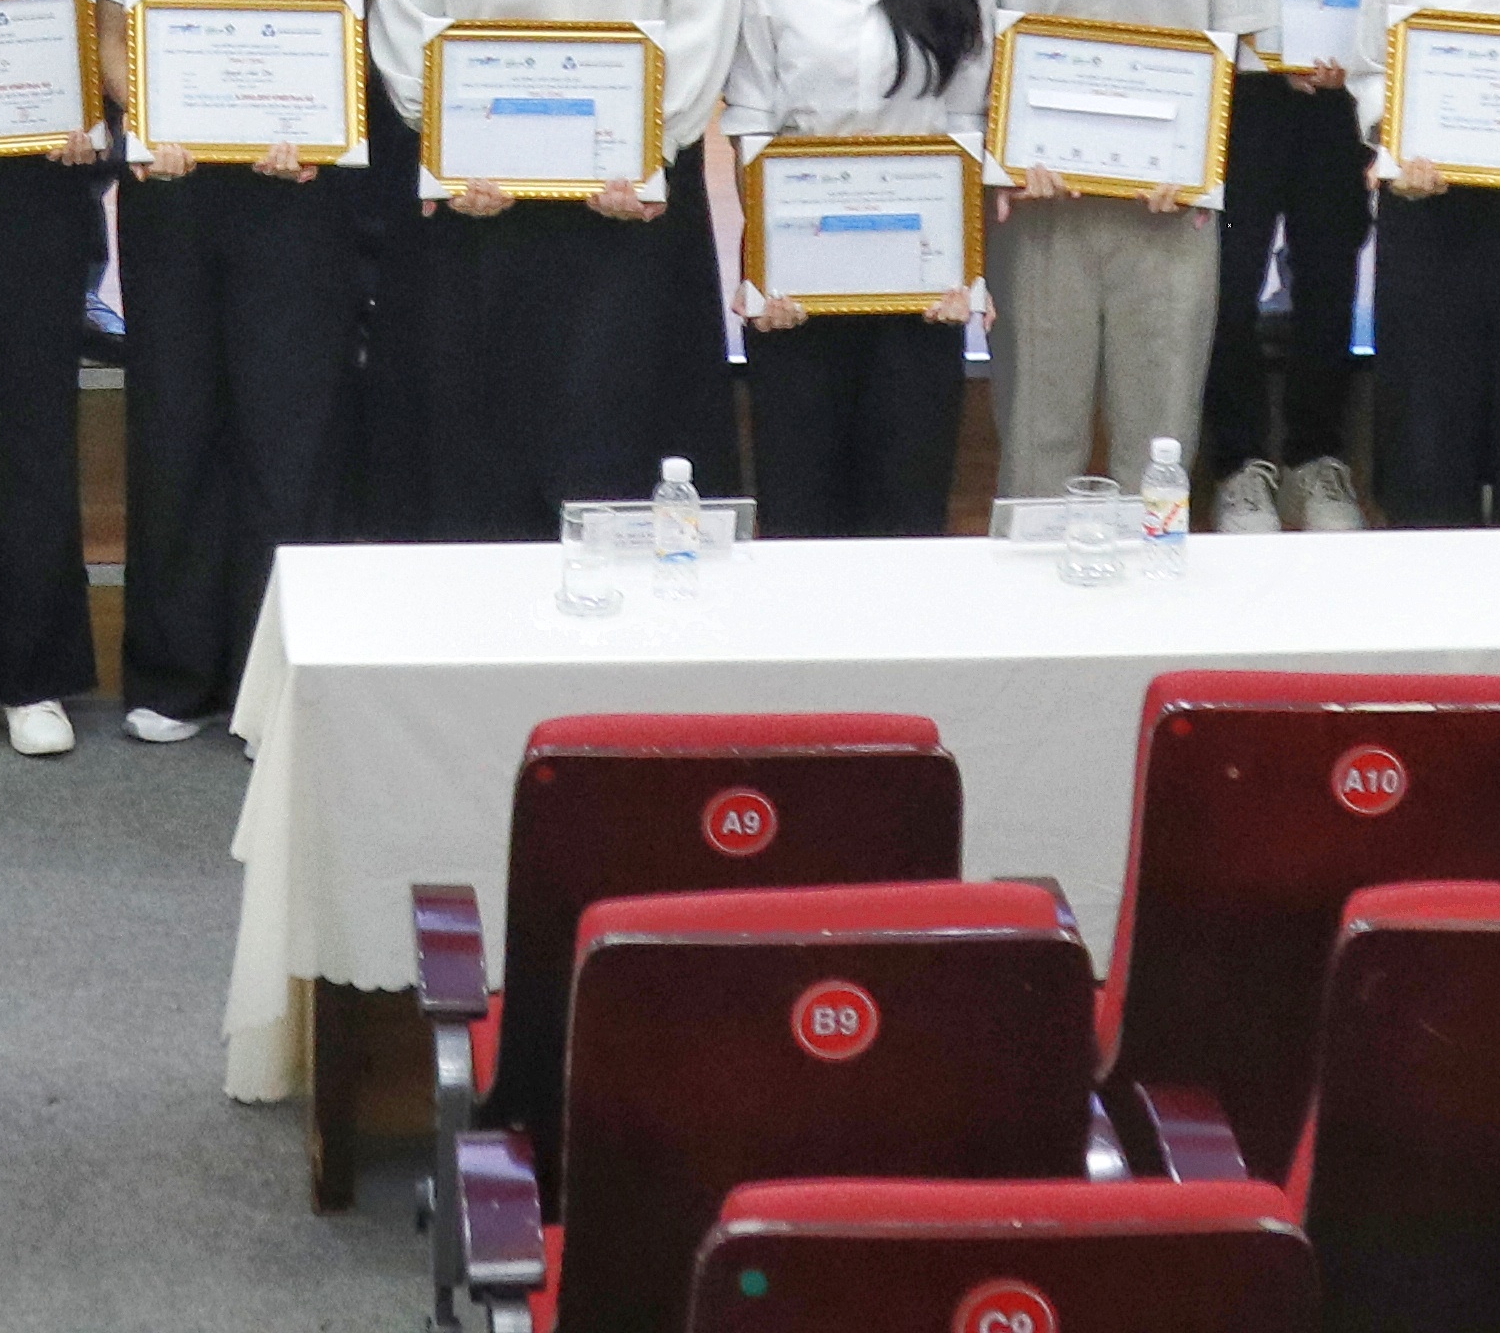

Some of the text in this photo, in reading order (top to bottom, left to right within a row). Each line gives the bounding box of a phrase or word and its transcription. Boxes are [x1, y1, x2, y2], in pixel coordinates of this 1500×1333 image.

[1344, 767, 1398, 795] A10
[722, 810, 762, 835] A9
[811, 1006, 858, 1036] B9
